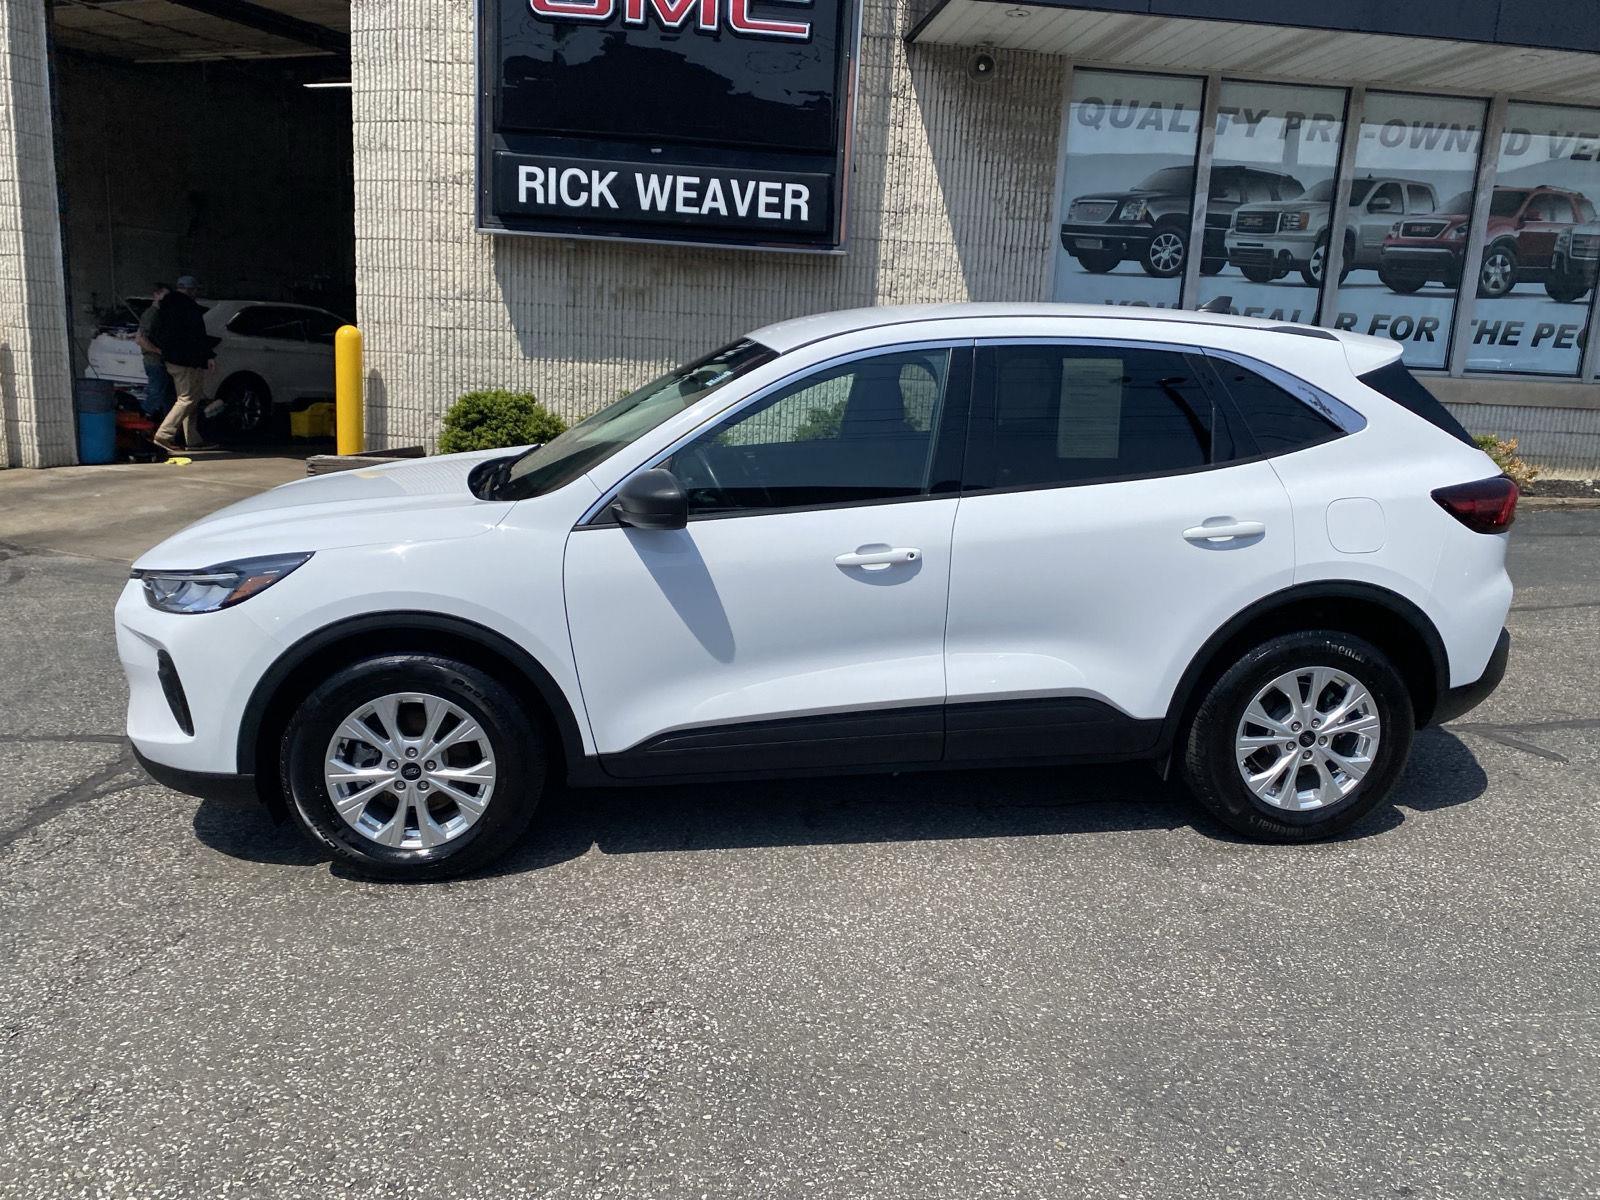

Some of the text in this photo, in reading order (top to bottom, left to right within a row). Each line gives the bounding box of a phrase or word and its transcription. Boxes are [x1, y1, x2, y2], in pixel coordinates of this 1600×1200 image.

[1077, 97, 1600, 162] QUALTY PR-OWND VE
[518, 165, 809, 221] RICK WEAVER
[1367, 314, 1440, 342] FOR
[1471, 319, 1525, 346] HE
[1530, 323, 1585, 349] PE
